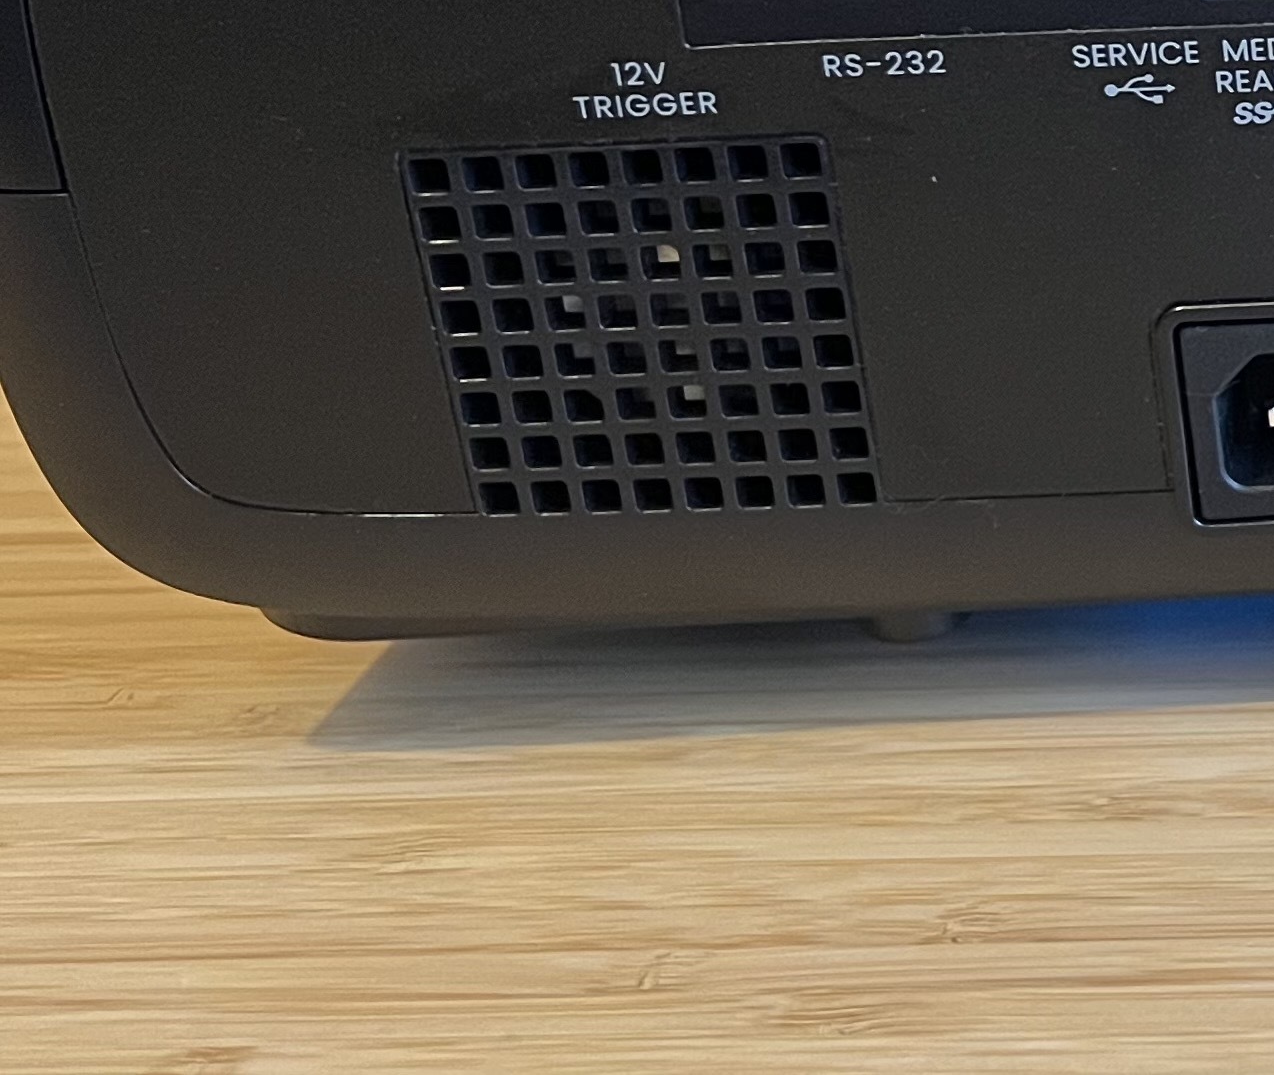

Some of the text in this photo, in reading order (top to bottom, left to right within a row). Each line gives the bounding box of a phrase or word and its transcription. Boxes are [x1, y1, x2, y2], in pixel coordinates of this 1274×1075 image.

[822, 49, 947, 78] RS-232
[1071, 40, 1200, 68] SERVICE
[610, 61, 665, 87] 12V
[572, 91, 718, 119] TRIGGER
